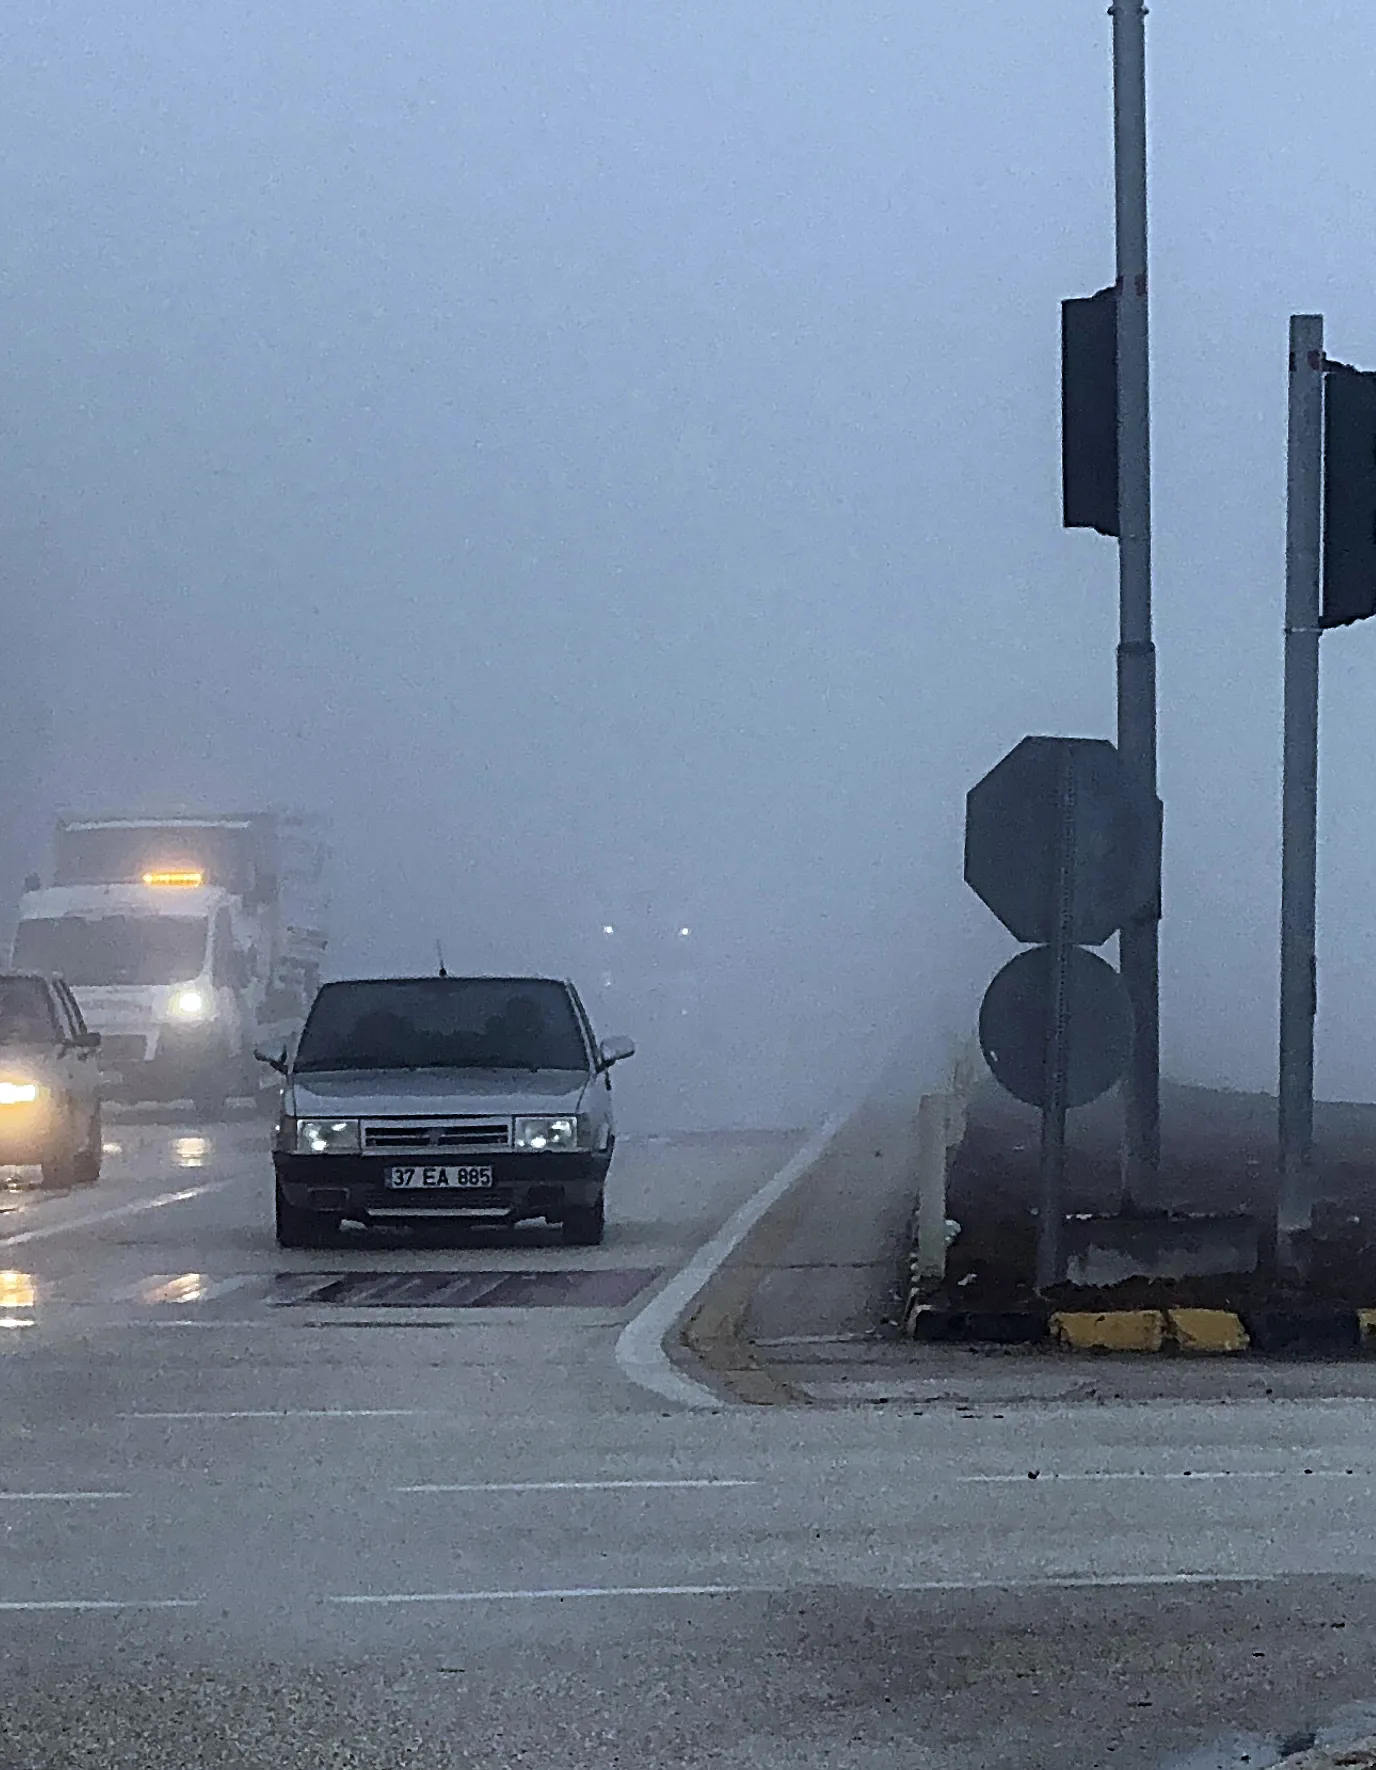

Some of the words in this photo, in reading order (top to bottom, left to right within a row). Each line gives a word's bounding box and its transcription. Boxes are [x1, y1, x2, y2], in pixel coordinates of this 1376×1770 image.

[393, 1168, 415, 1186] 37
[422, 1167, 449, 1186] EA
[457, 1167, 490, 1186] 885
